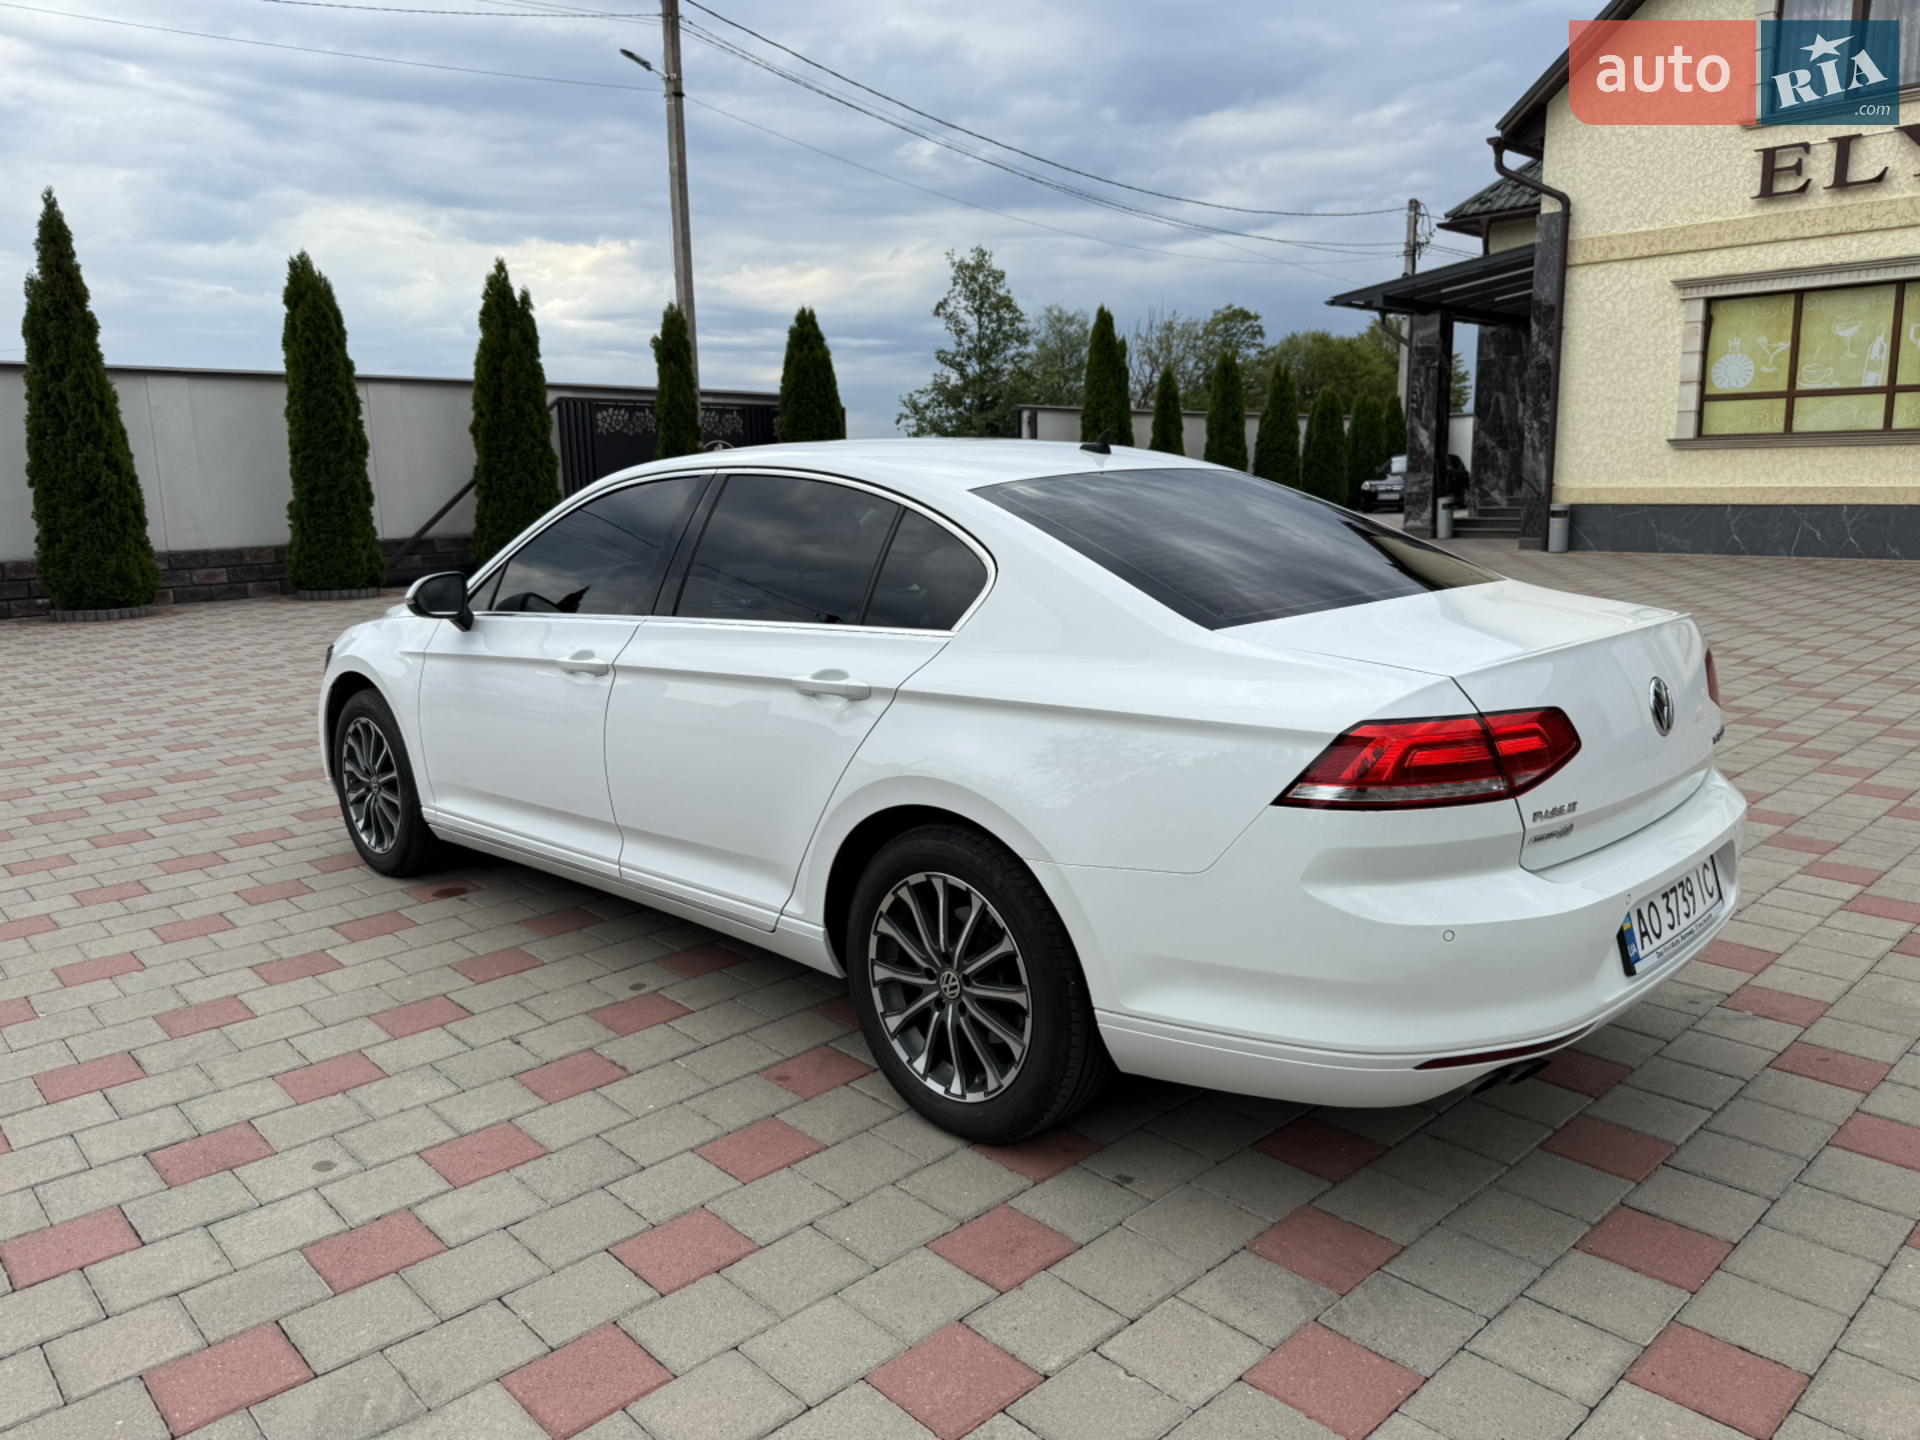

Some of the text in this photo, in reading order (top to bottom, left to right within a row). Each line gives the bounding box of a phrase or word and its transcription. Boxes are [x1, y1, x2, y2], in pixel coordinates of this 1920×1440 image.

[1637, 900, 1662, 950] AO
[1661, 876, 1696, 930] 3739
[1696, 862, 1714, 906] IC
[1628, 943, 1638, 956] UA
